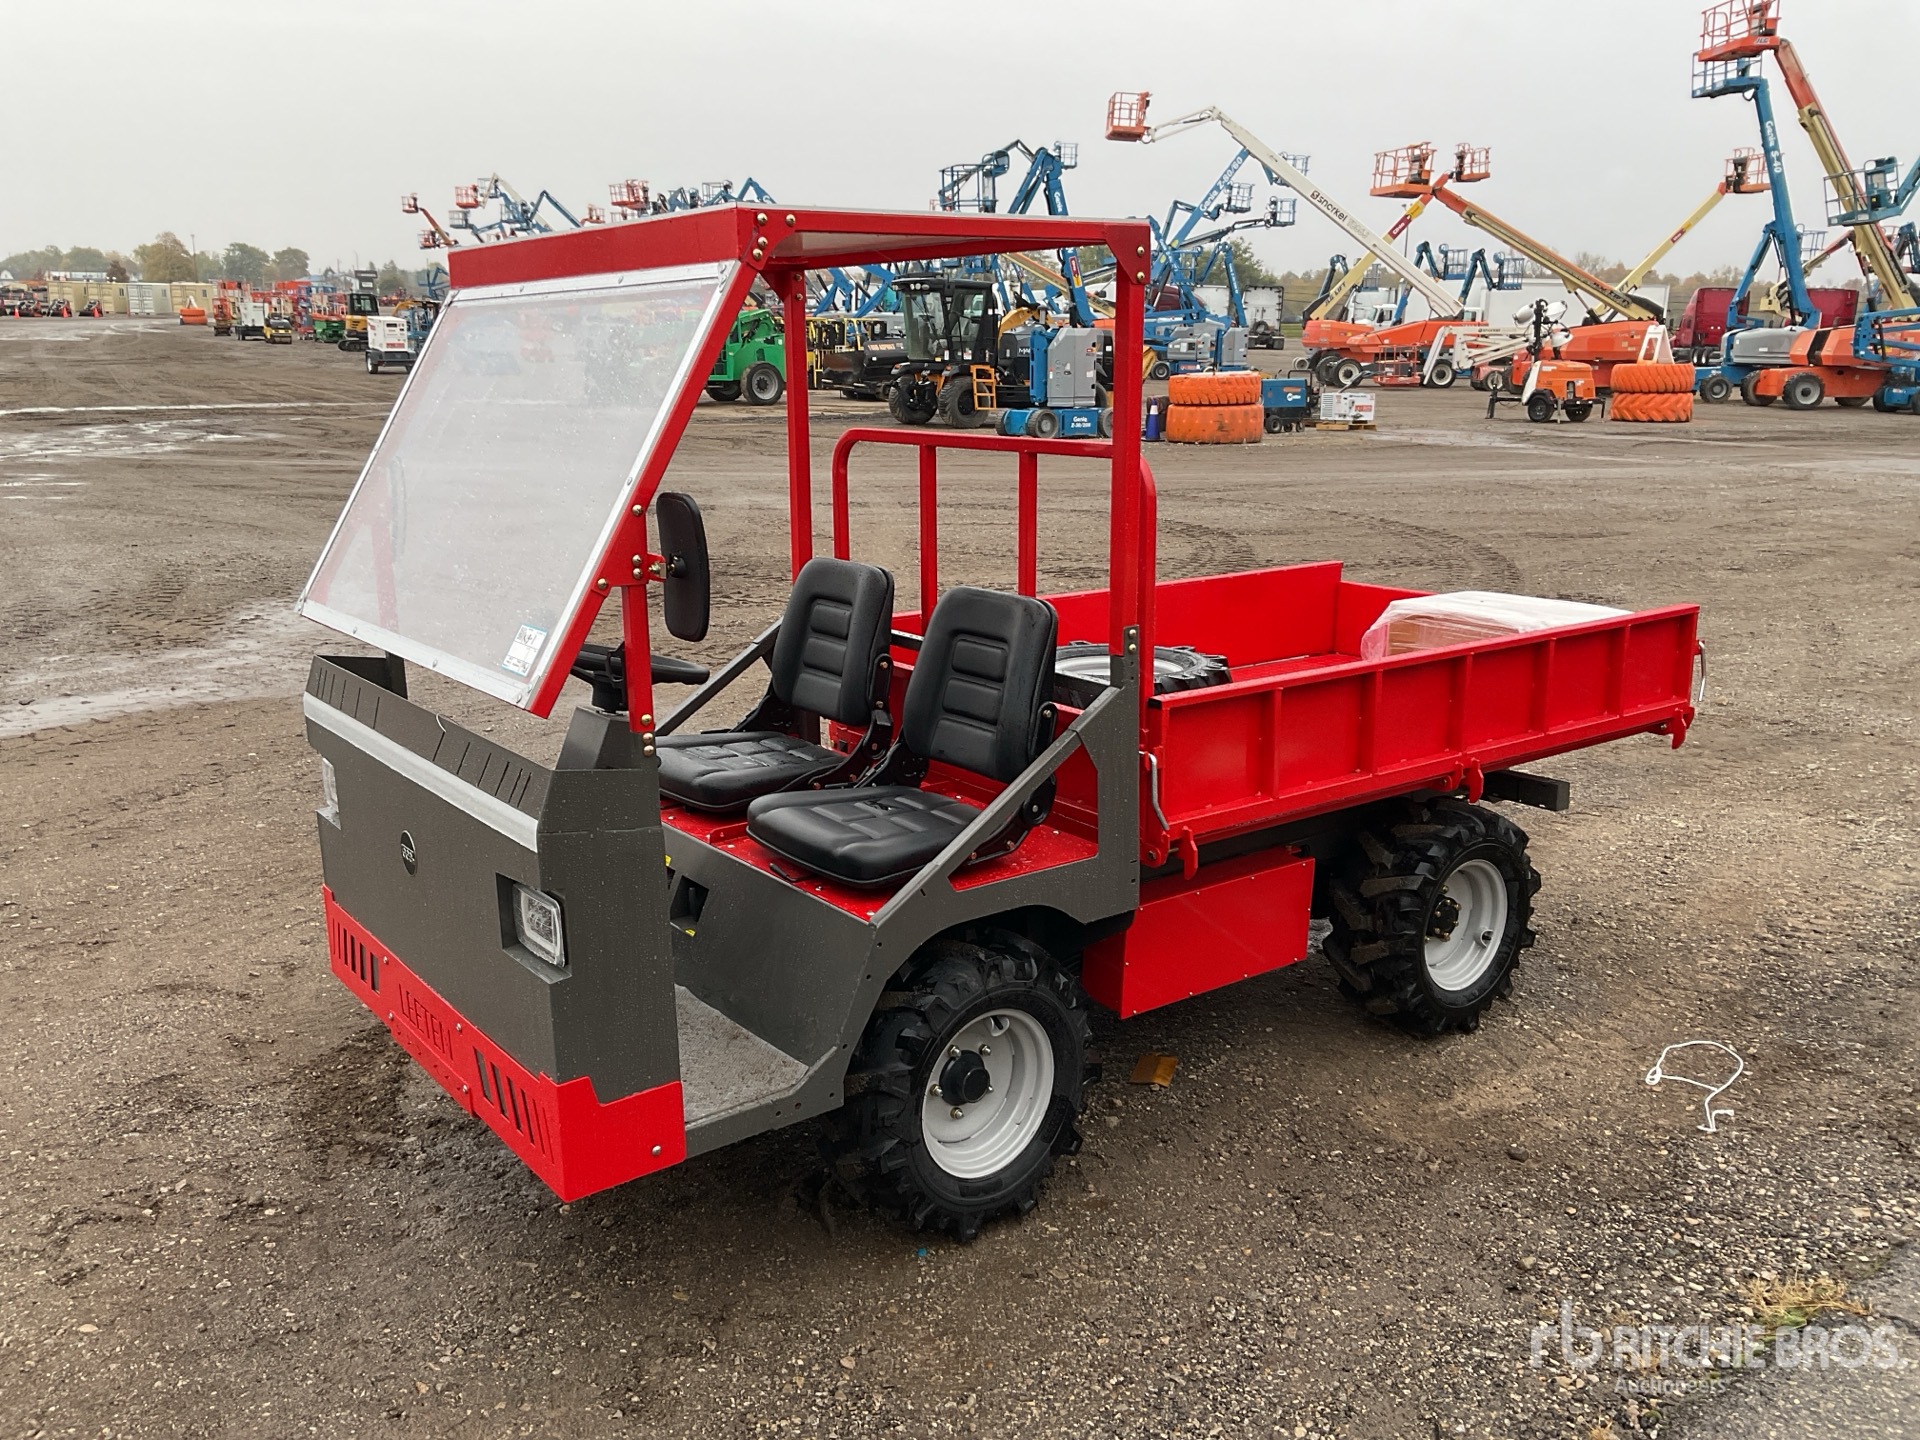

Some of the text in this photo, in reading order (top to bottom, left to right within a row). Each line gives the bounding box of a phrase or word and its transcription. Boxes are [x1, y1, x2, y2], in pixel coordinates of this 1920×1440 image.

[1765, 120, 1782, 173] Genie S-40
[1199, 190, 1219, 211] Genie
[1316, 195, 1348, 222] snorkel
